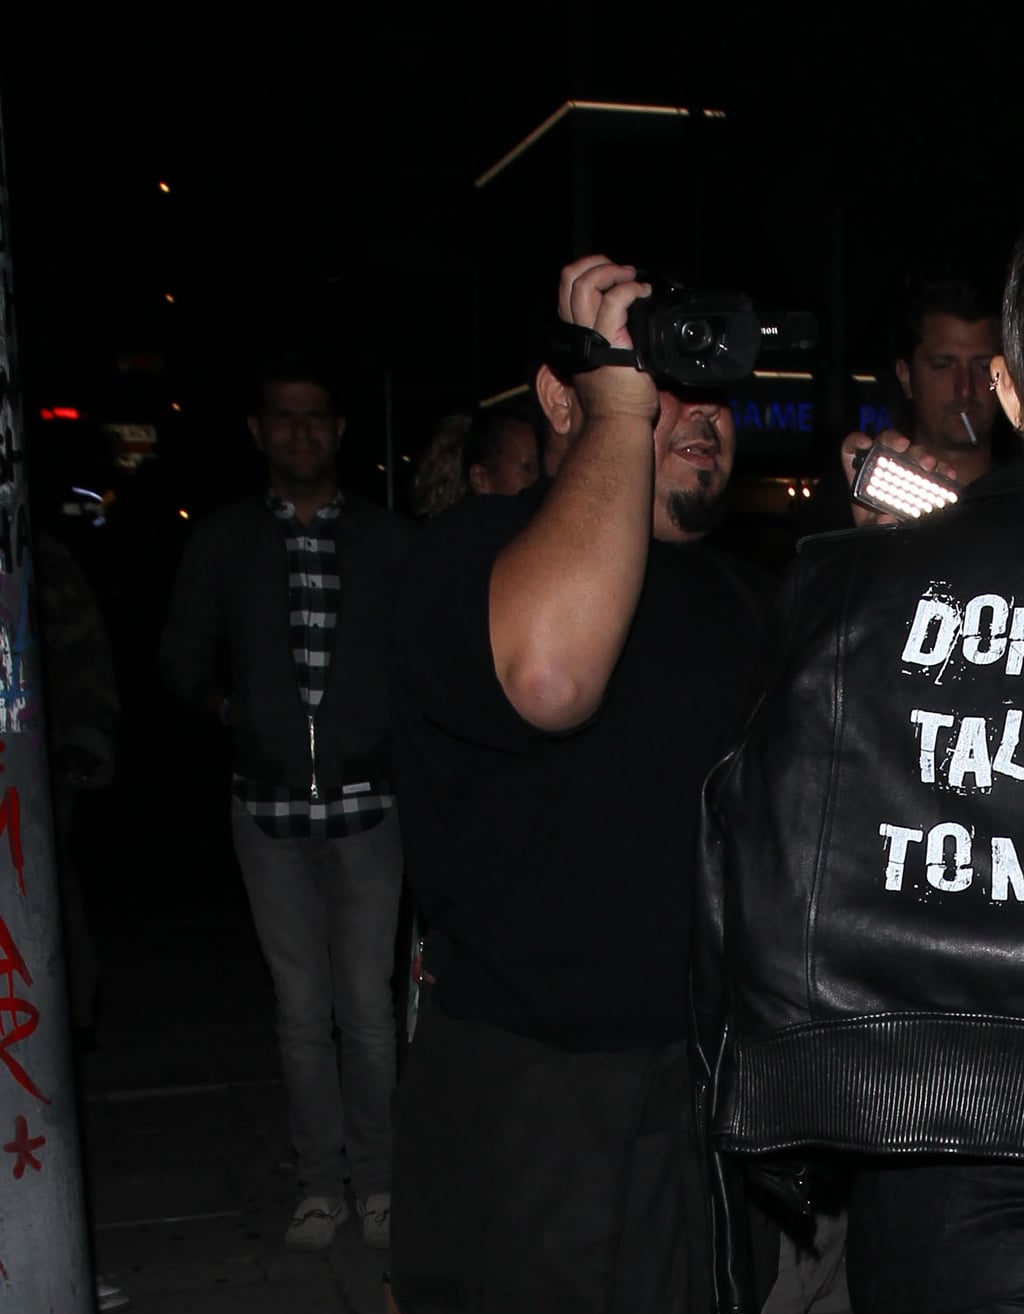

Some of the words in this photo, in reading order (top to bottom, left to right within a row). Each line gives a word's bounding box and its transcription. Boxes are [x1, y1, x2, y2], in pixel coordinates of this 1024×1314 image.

[760, 327, 779, 335] non
[731, 400, 814, 433] GAME
[879, 822, 974, 892] TO
